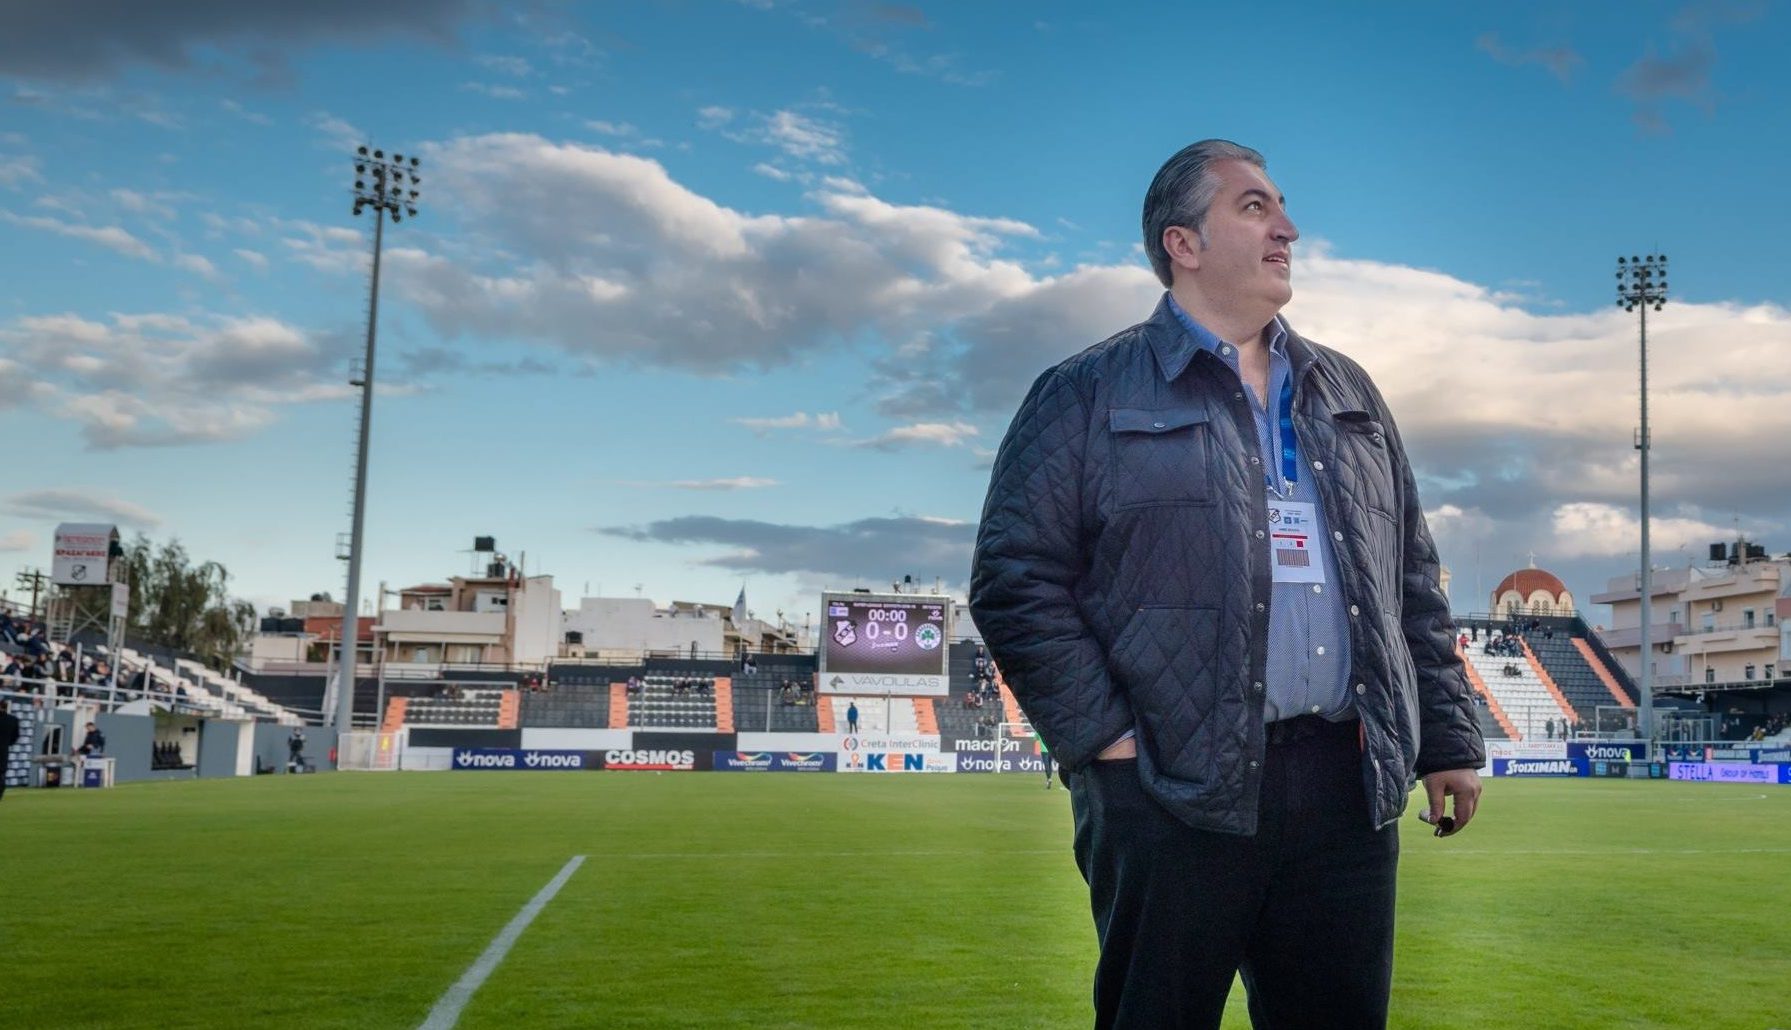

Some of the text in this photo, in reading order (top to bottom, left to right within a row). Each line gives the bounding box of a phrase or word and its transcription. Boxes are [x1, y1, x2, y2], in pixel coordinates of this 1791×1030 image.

[868, 609, 907, 621] 00:00
[852, 676, 939, 687] VAVOULAS
[861, 740, 938, 749] Creta InterClinic
[955, 738, 1019, 752] macron
[473, 754, 580, 767] nova nova
[605, 750, 694, 765] COSMOS
[867, 754, 923, 770] KEN
[1678, 764, 1713, 780] STELLA
